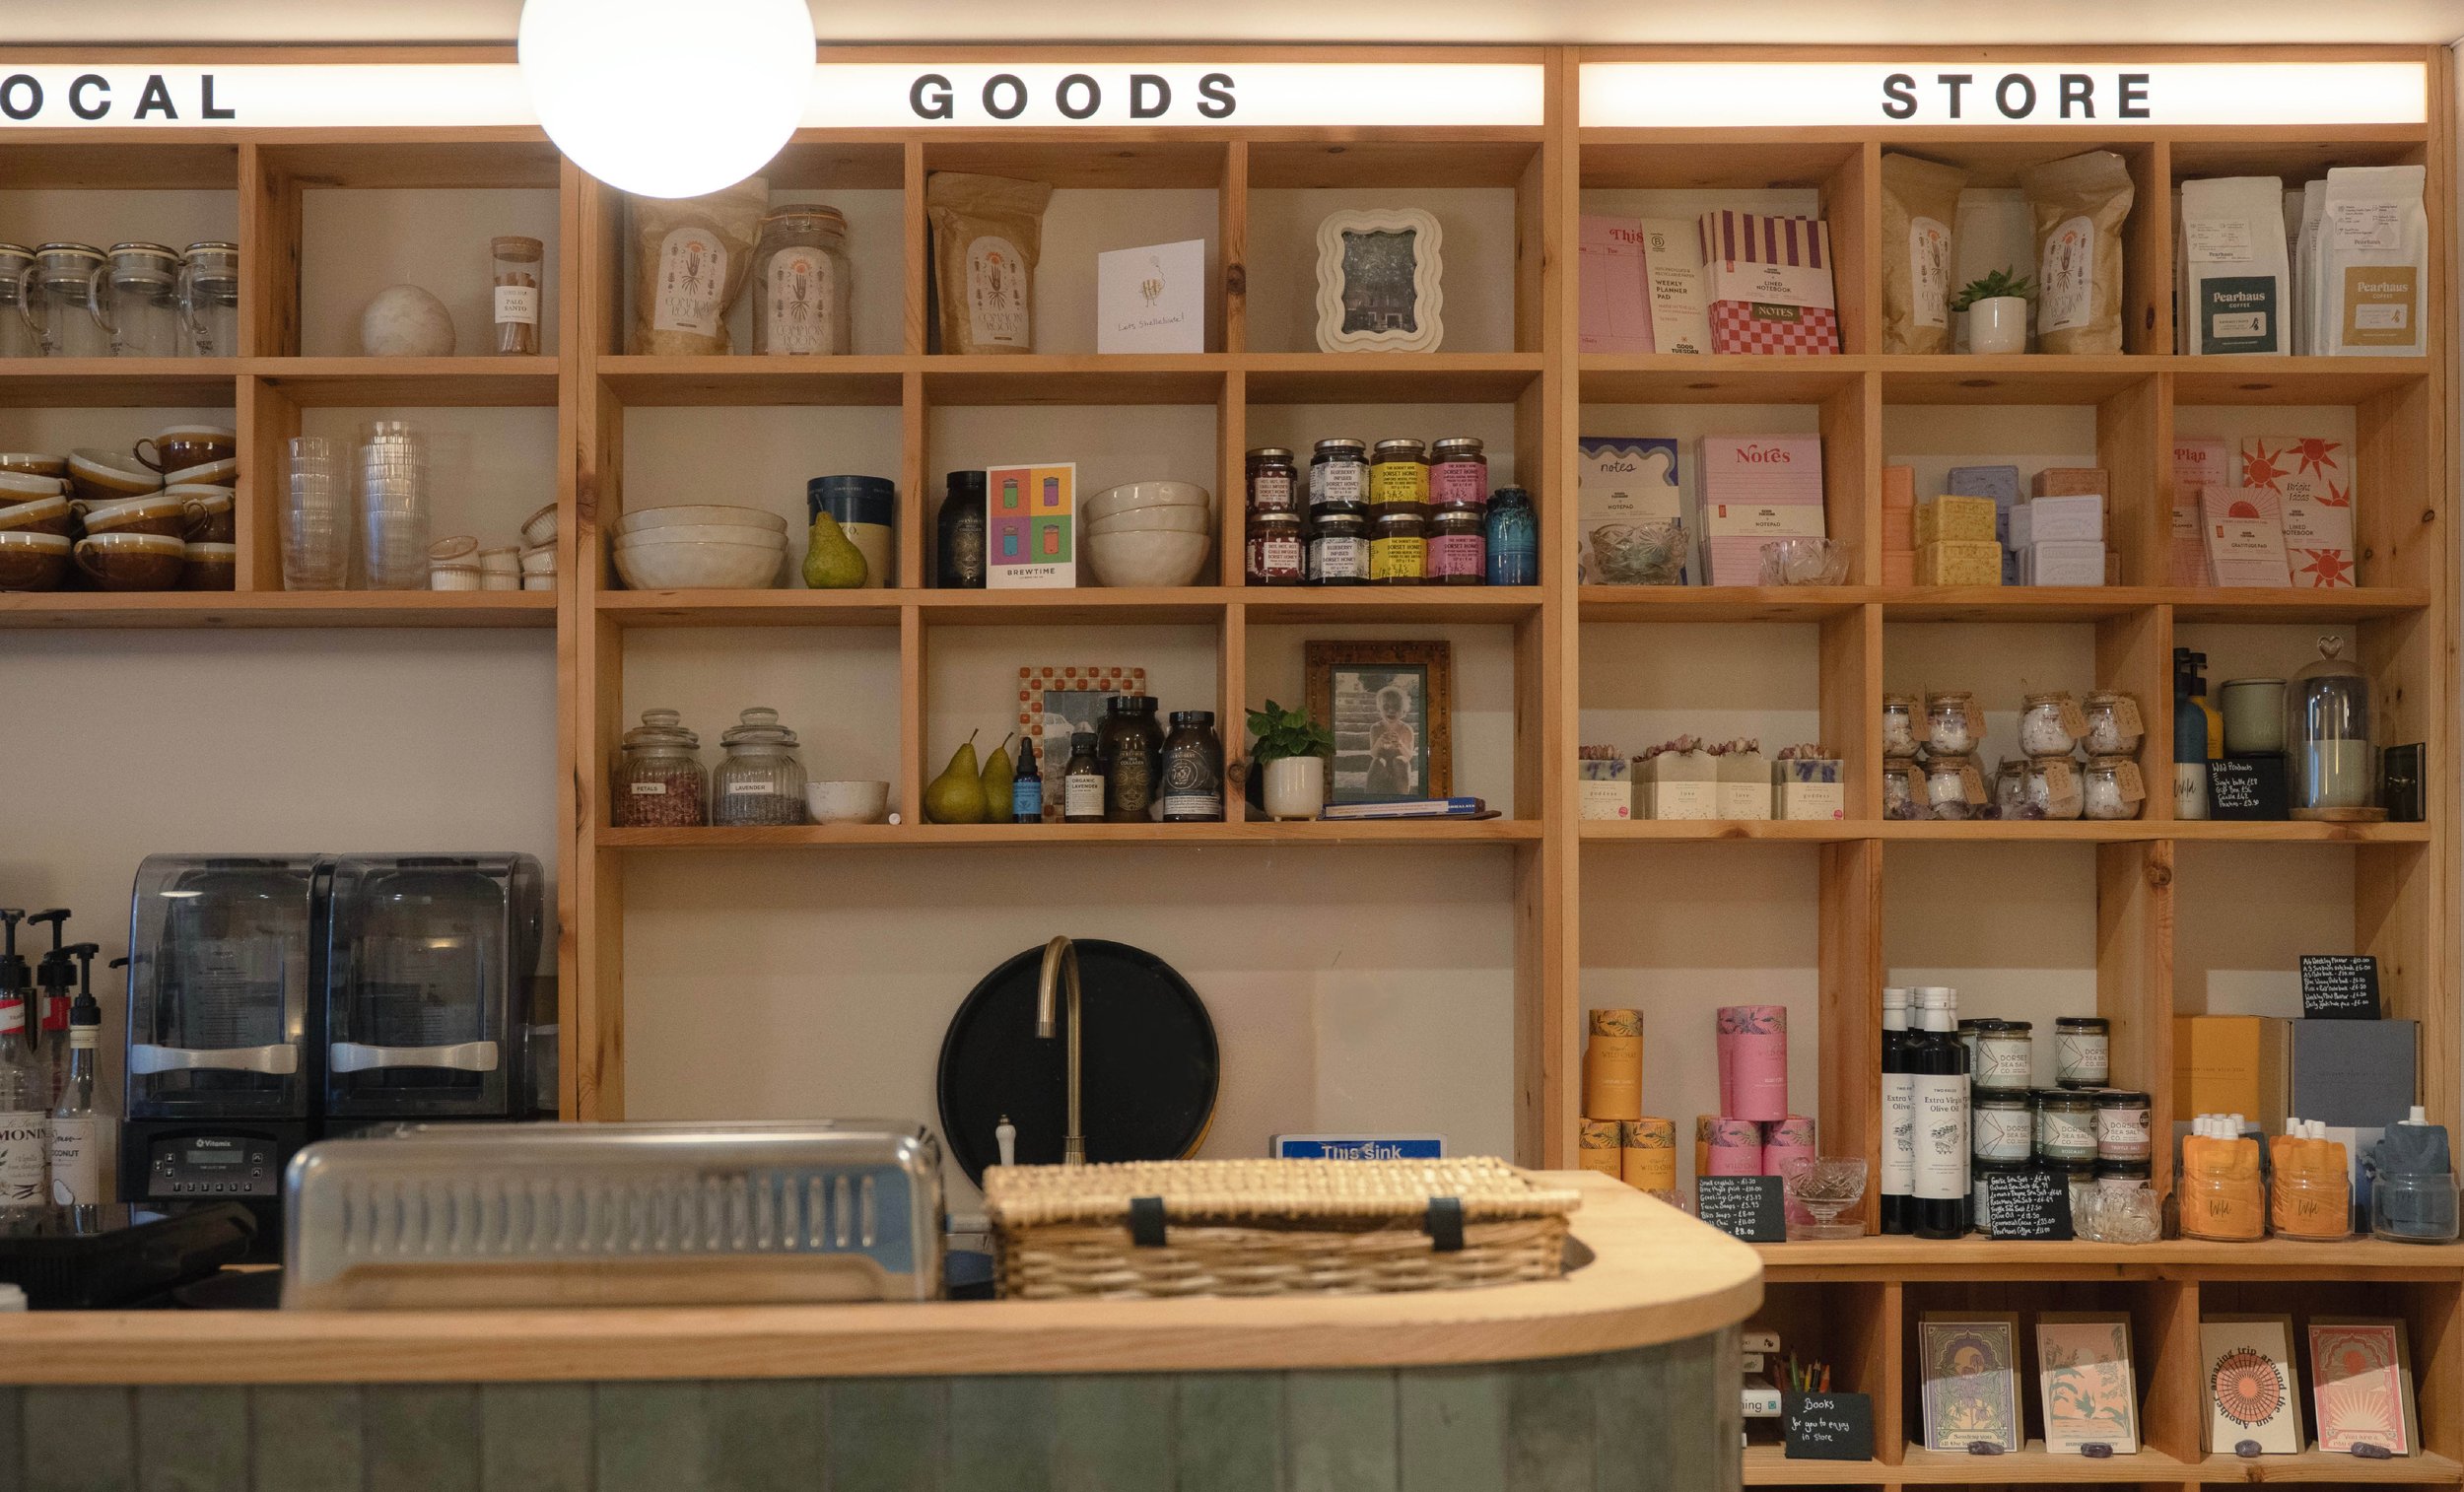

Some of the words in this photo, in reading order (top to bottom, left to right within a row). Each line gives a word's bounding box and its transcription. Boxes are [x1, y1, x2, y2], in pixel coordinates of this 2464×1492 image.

[0, 74, 236, 120] OCAL
[910, 74, 1237, 119] GOODS
[1882, 74, 2151, 119] STORE
[1609, 229, 1643, 243] This
[2358, 282, 2409, 294] Pearhaus
[2213, 292, 2266, 304] Pearhaus
[1758, 306, 1794, 317] NOTES
[1737, 444, 1791, 463] Notes
[2174, 448, 2207, 463] Plan
[1601, 460, 1637, 473] notes
[2213, 763, 2227, 772] Wild
[2227, 761, 2253, 771] Products
[1946, 1097, 1961, 1106] Virgi
[1322, 1145, 1360, 1159] This
[1364, 1144, 1402, 1160] sink
[2209, 1198, 2231, 1217] Wild
[2297, 1198, 2319, 1216] Wild
[1735, 1226, 1755, 1236] £8.00
[2238, 1346, 2257, 1357] trip
[2210, 1348, 2234, 1391] amazing
[2261, 1354, 2287, 1390] around
[1804, 1398, 1834, 1410] Books
[2276, 1396, 2287, 1413] the
[2213, 1396, 2250, 1430] Another
[2256, 1414, 2274, 1427] sun
[1792, 1417, 1802, 1431] for
[1805, 1421, 1817, 1433] you
[1819, 1417, 1826, 1427] to
[1828, 1421, 1850, 1432] enjoy
[1814, 1432, 1833, 1442] store
